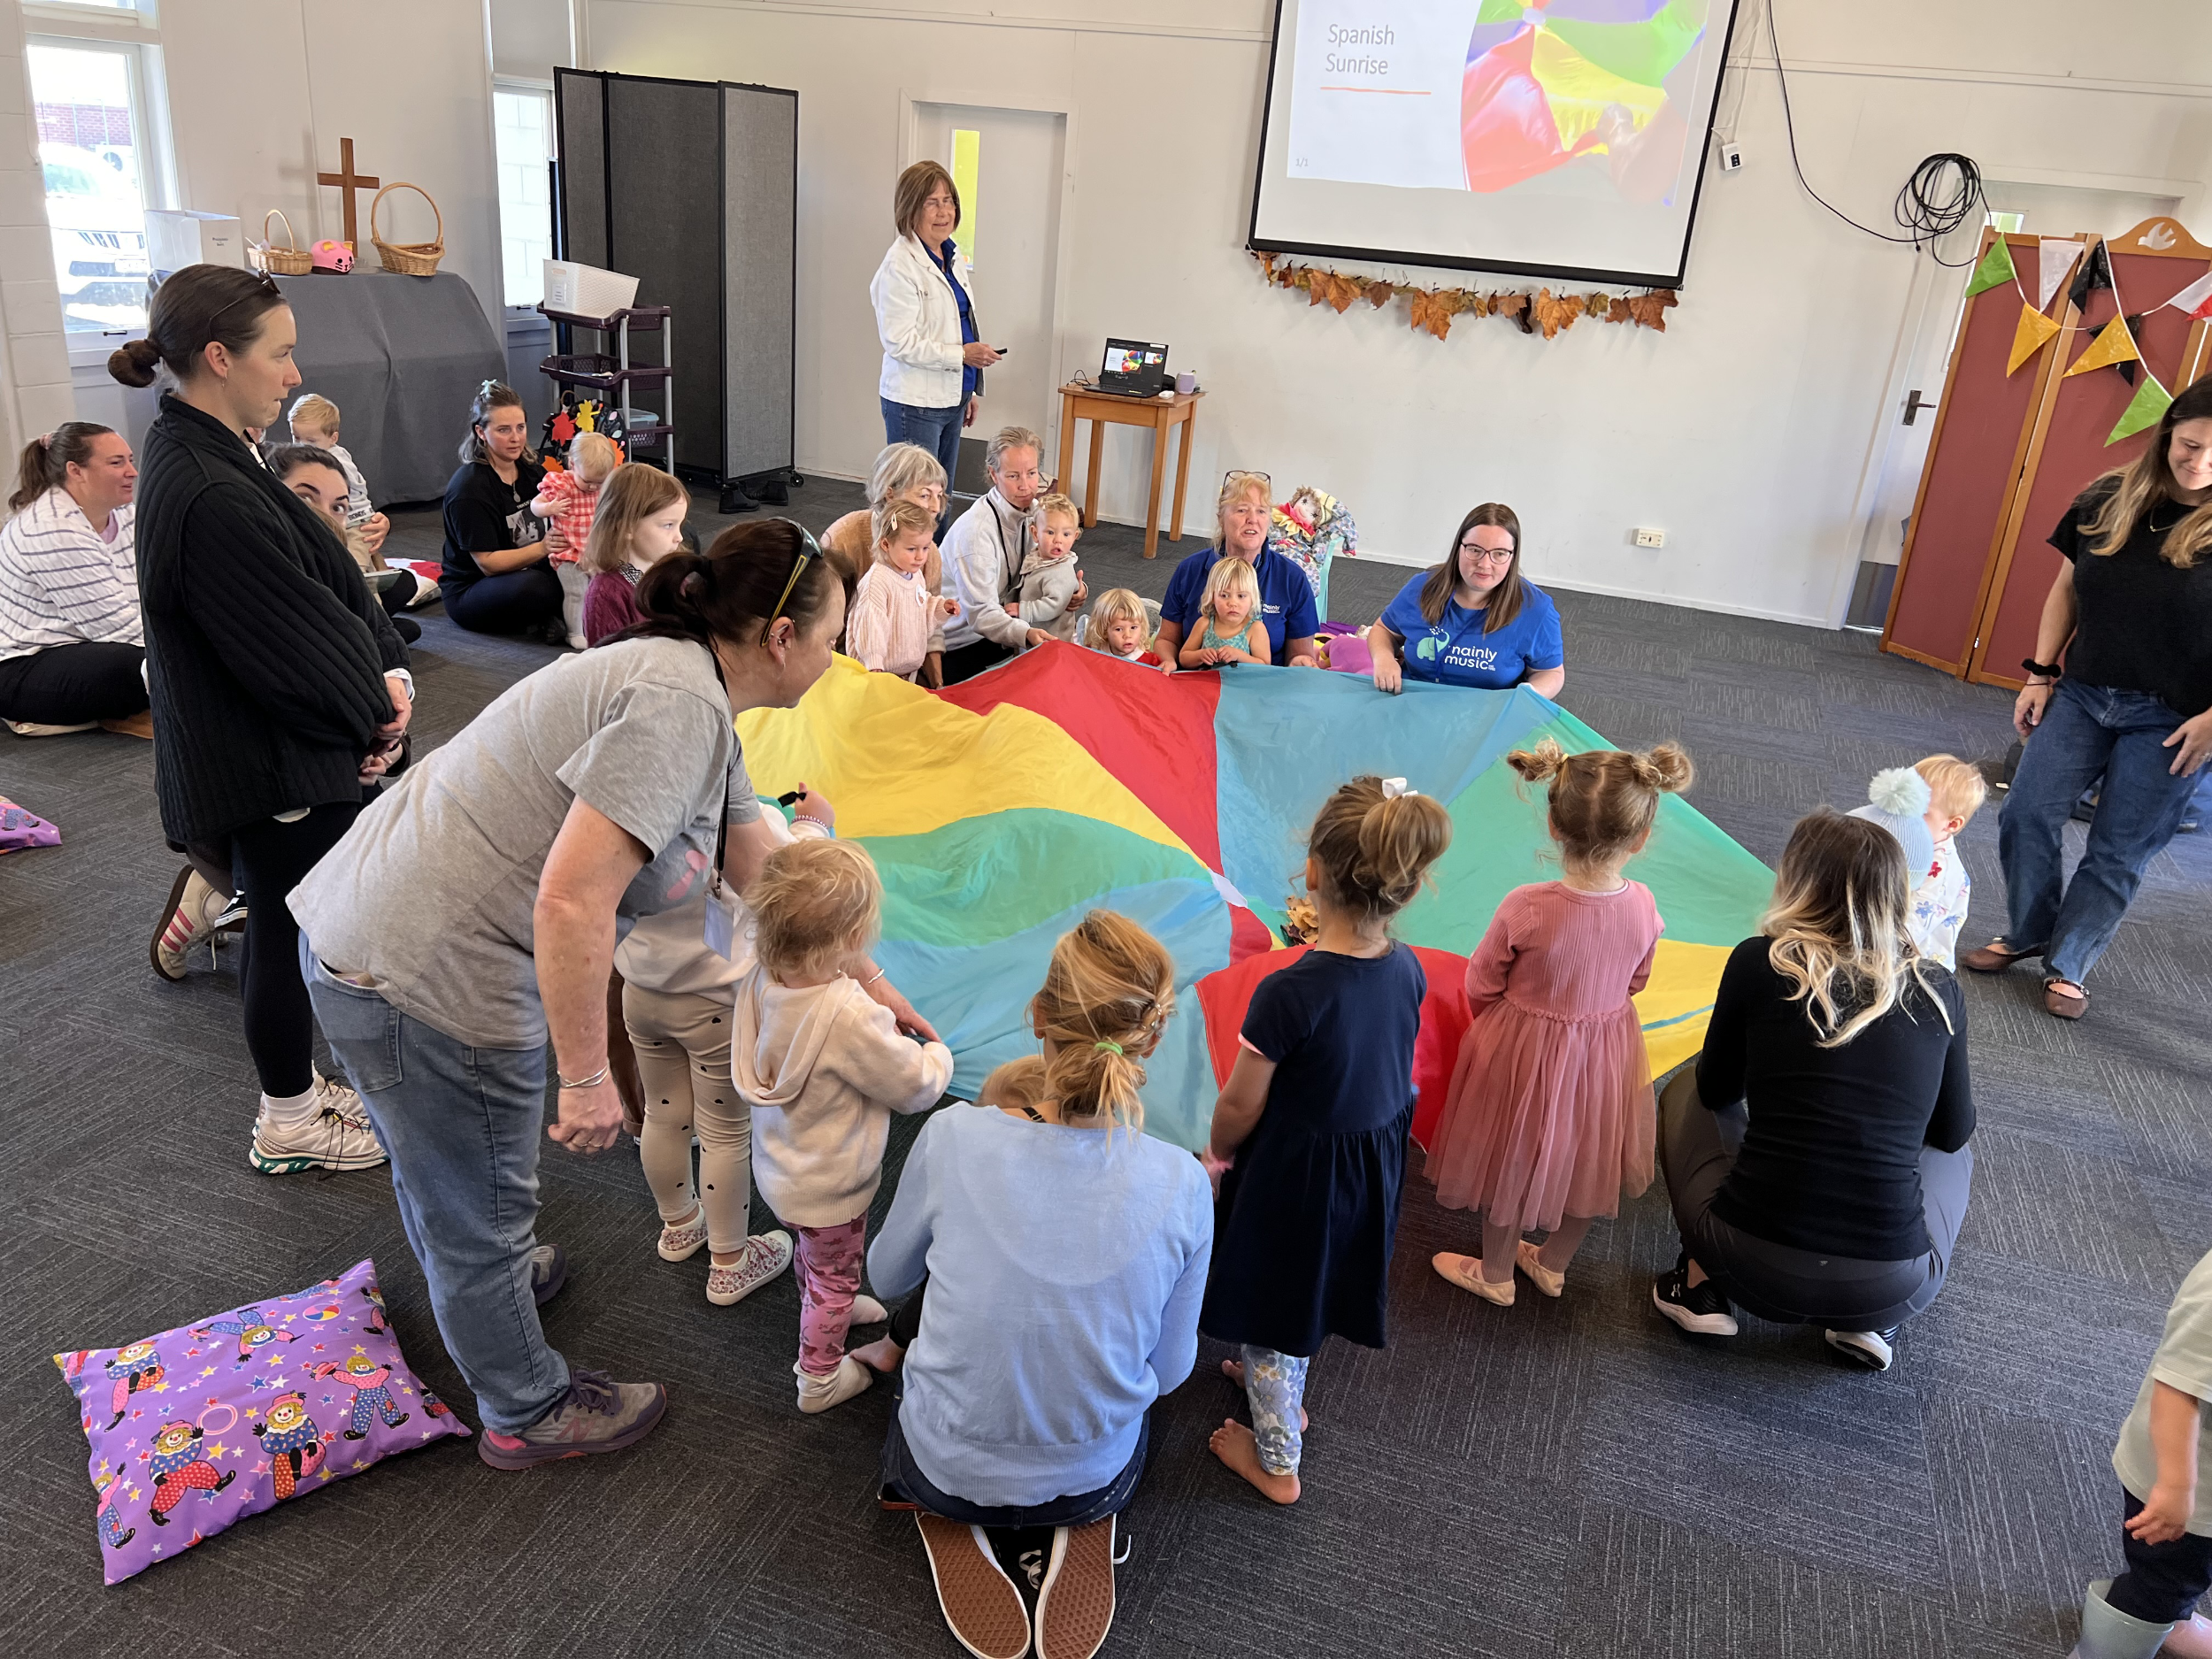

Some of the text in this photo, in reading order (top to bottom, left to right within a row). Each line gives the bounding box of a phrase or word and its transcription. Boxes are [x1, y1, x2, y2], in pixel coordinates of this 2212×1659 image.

[1327, 23, 1394, 48] Spanish
[1325, 52, 1388, 74] Sunrise
[1295, 157, 1309, 167] 1/1
[1444, 655, 1489, 670] music
